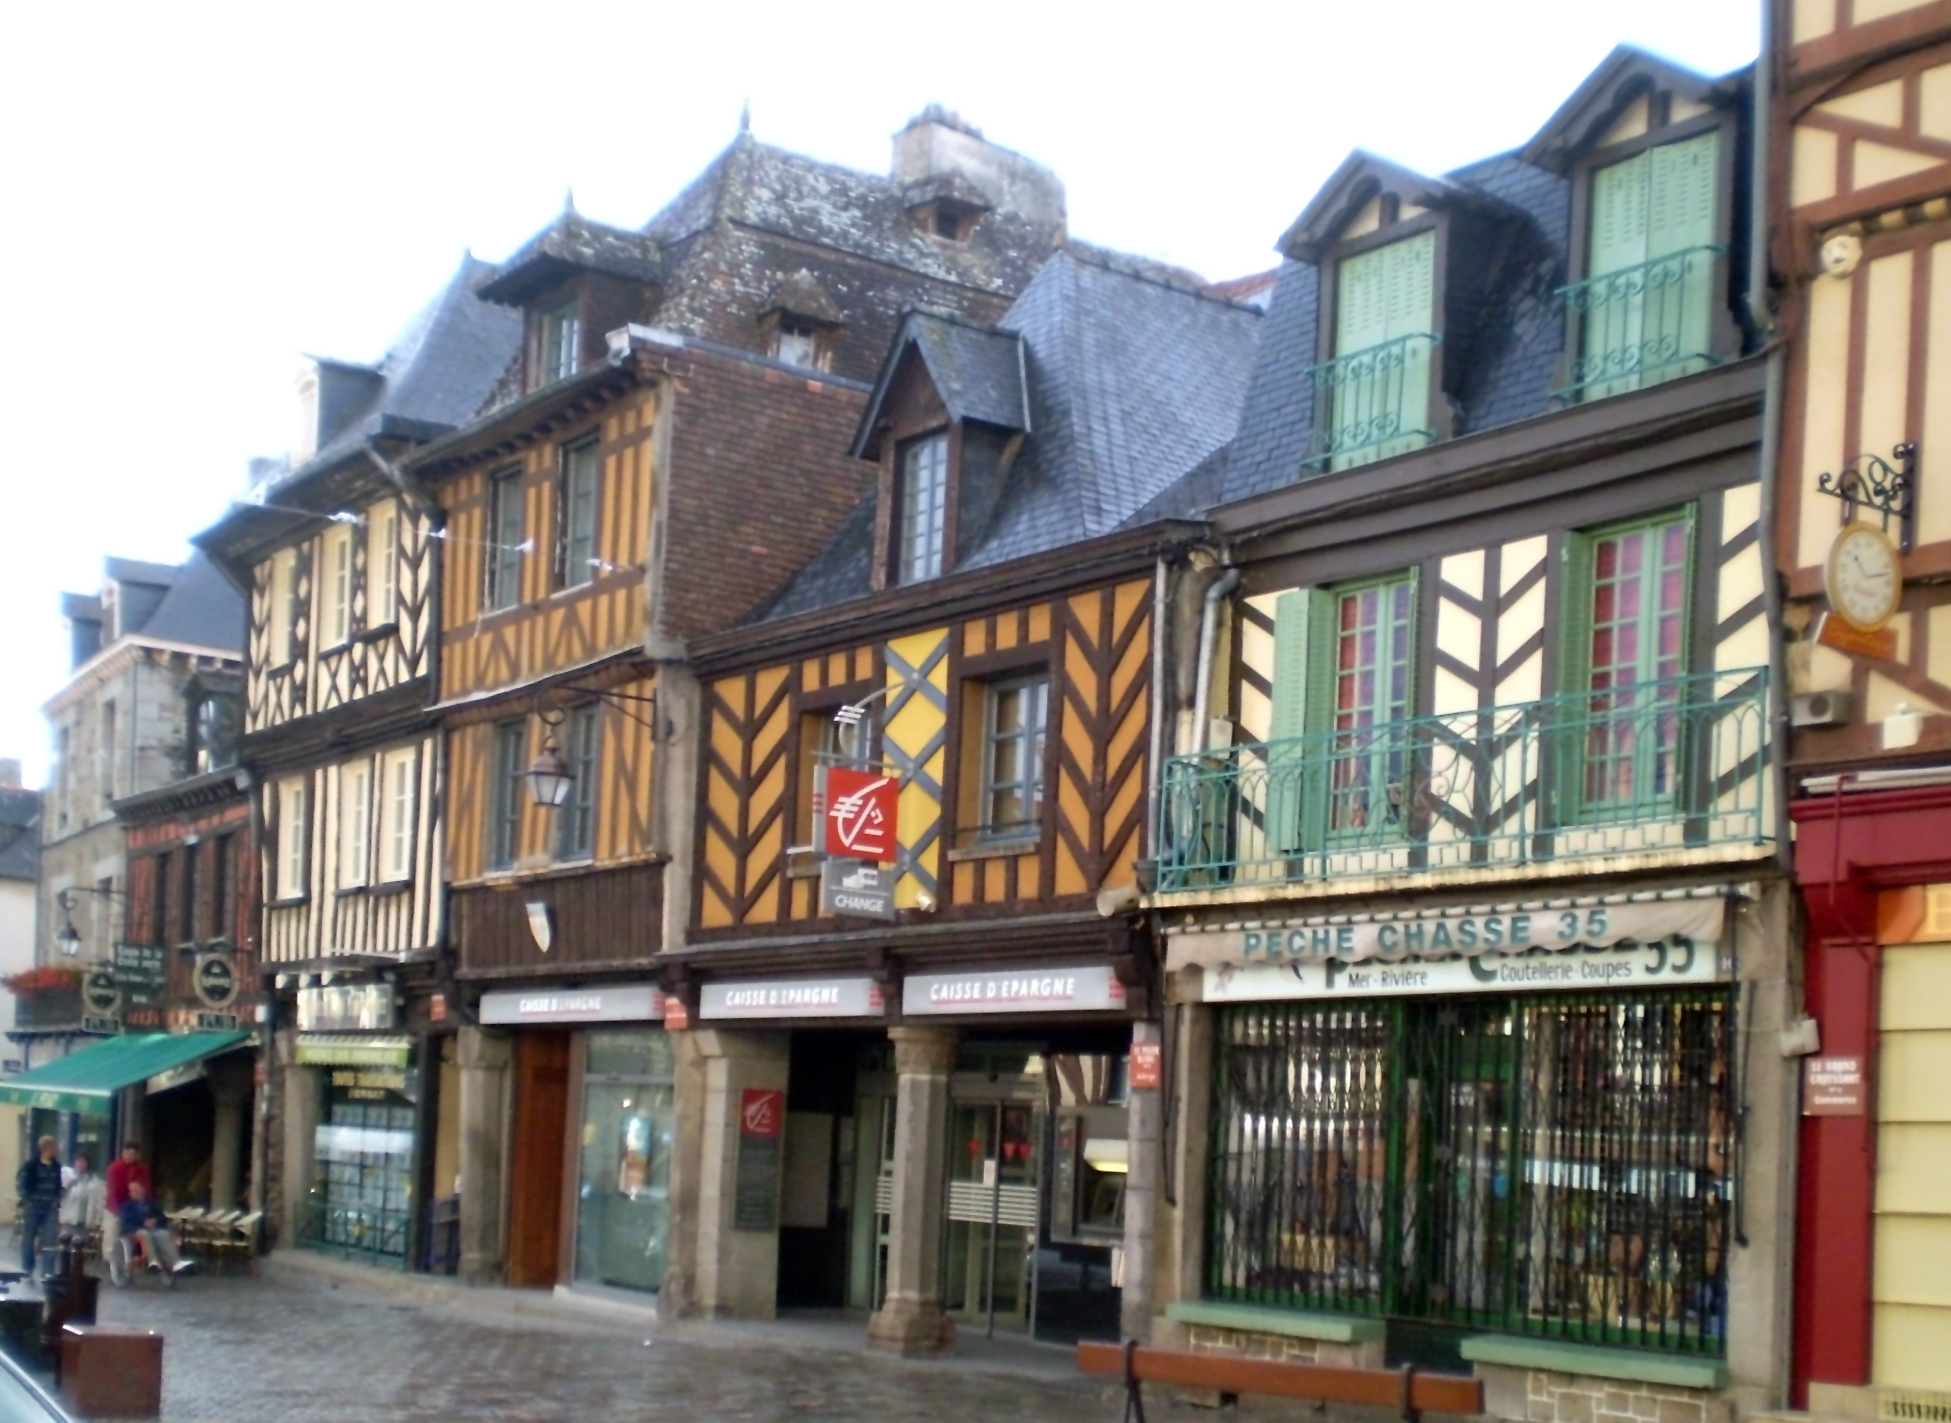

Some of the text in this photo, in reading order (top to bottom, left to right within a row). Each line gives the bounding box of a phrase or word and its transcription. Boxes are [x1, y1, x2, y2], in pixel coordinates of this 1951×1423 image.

[834, 893, 884, 913] CHANGE
[1243, 909, 1608, 958] PECHE CHASSE 35
[1348, 971, 1372, 989] Mer
[1500, 962, 1574, 982] Coutellerie
[1580, 960, 1633, 985] Coupes
[725, 989, 766, 1007] CAISSE
[930, 981, 982, 1001] CAISSE
